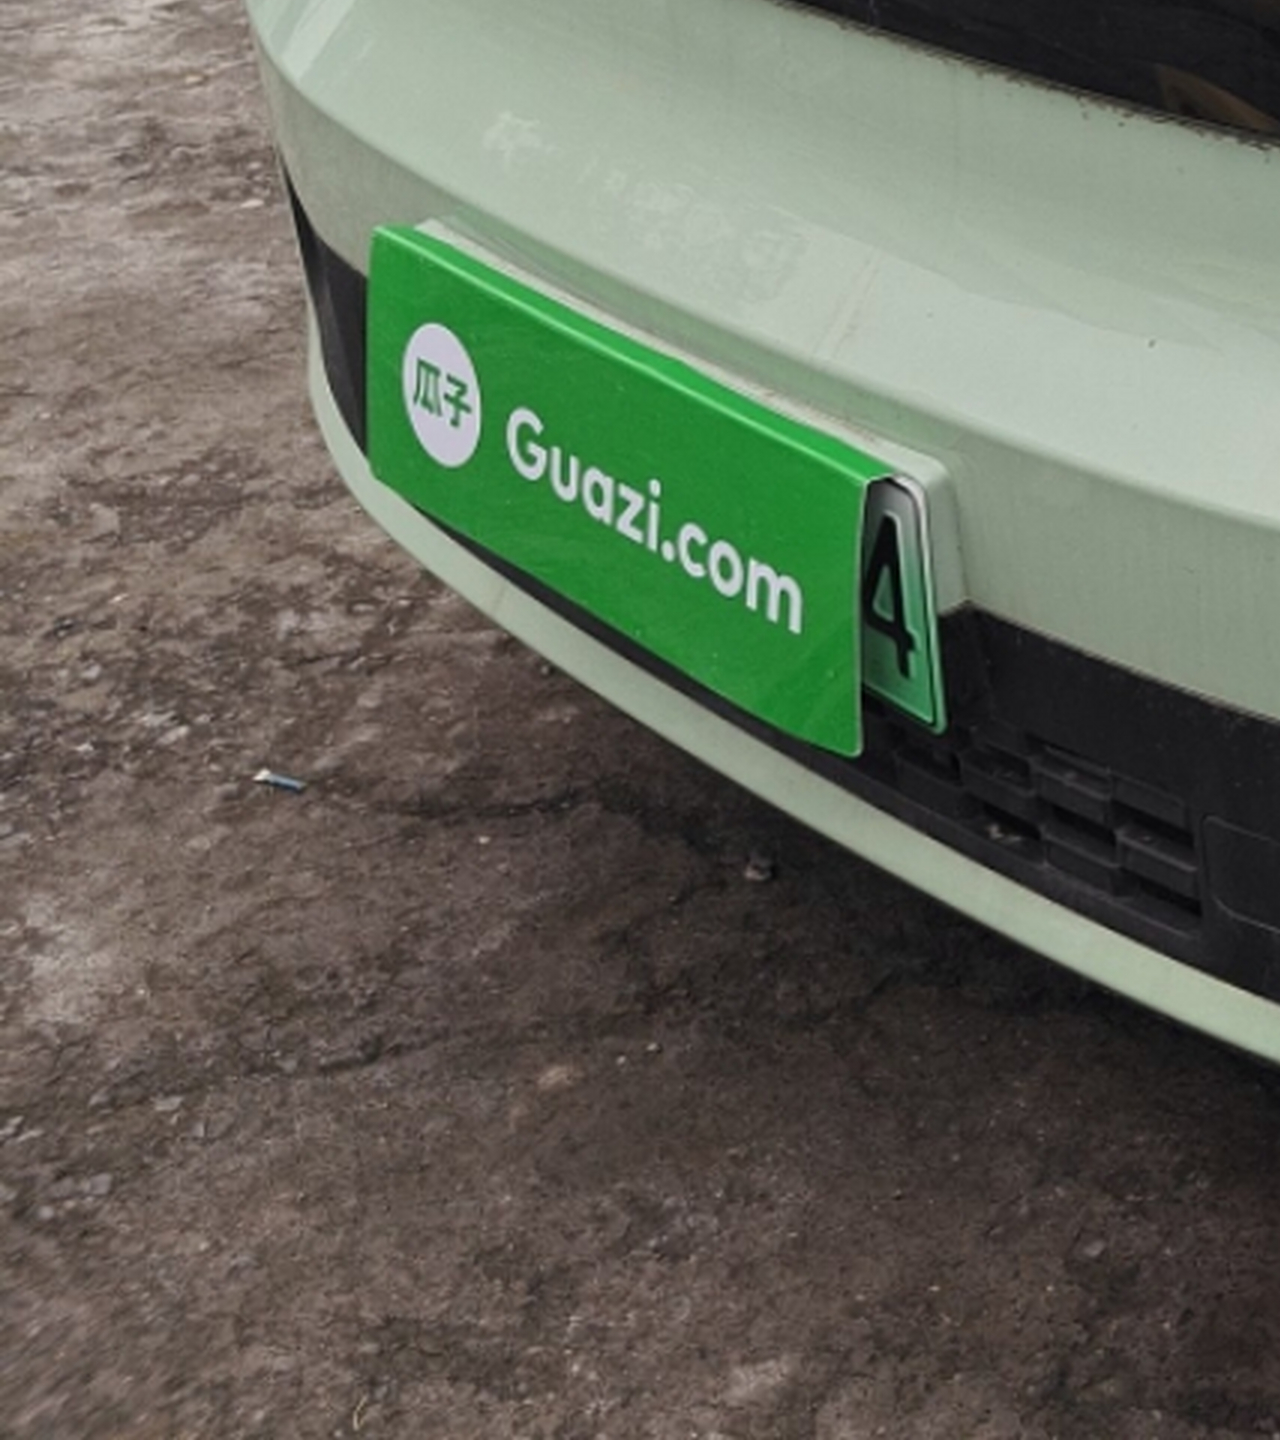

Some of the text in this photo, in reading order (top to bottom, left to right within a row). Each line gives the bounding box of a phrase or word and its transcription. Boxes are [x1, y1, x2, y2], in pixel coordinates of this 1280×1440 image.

[413, 359, 472, 427] 瓜子
[507, 407, 801, 635] Guazi.com
[865, 513, 916, 679] 4
